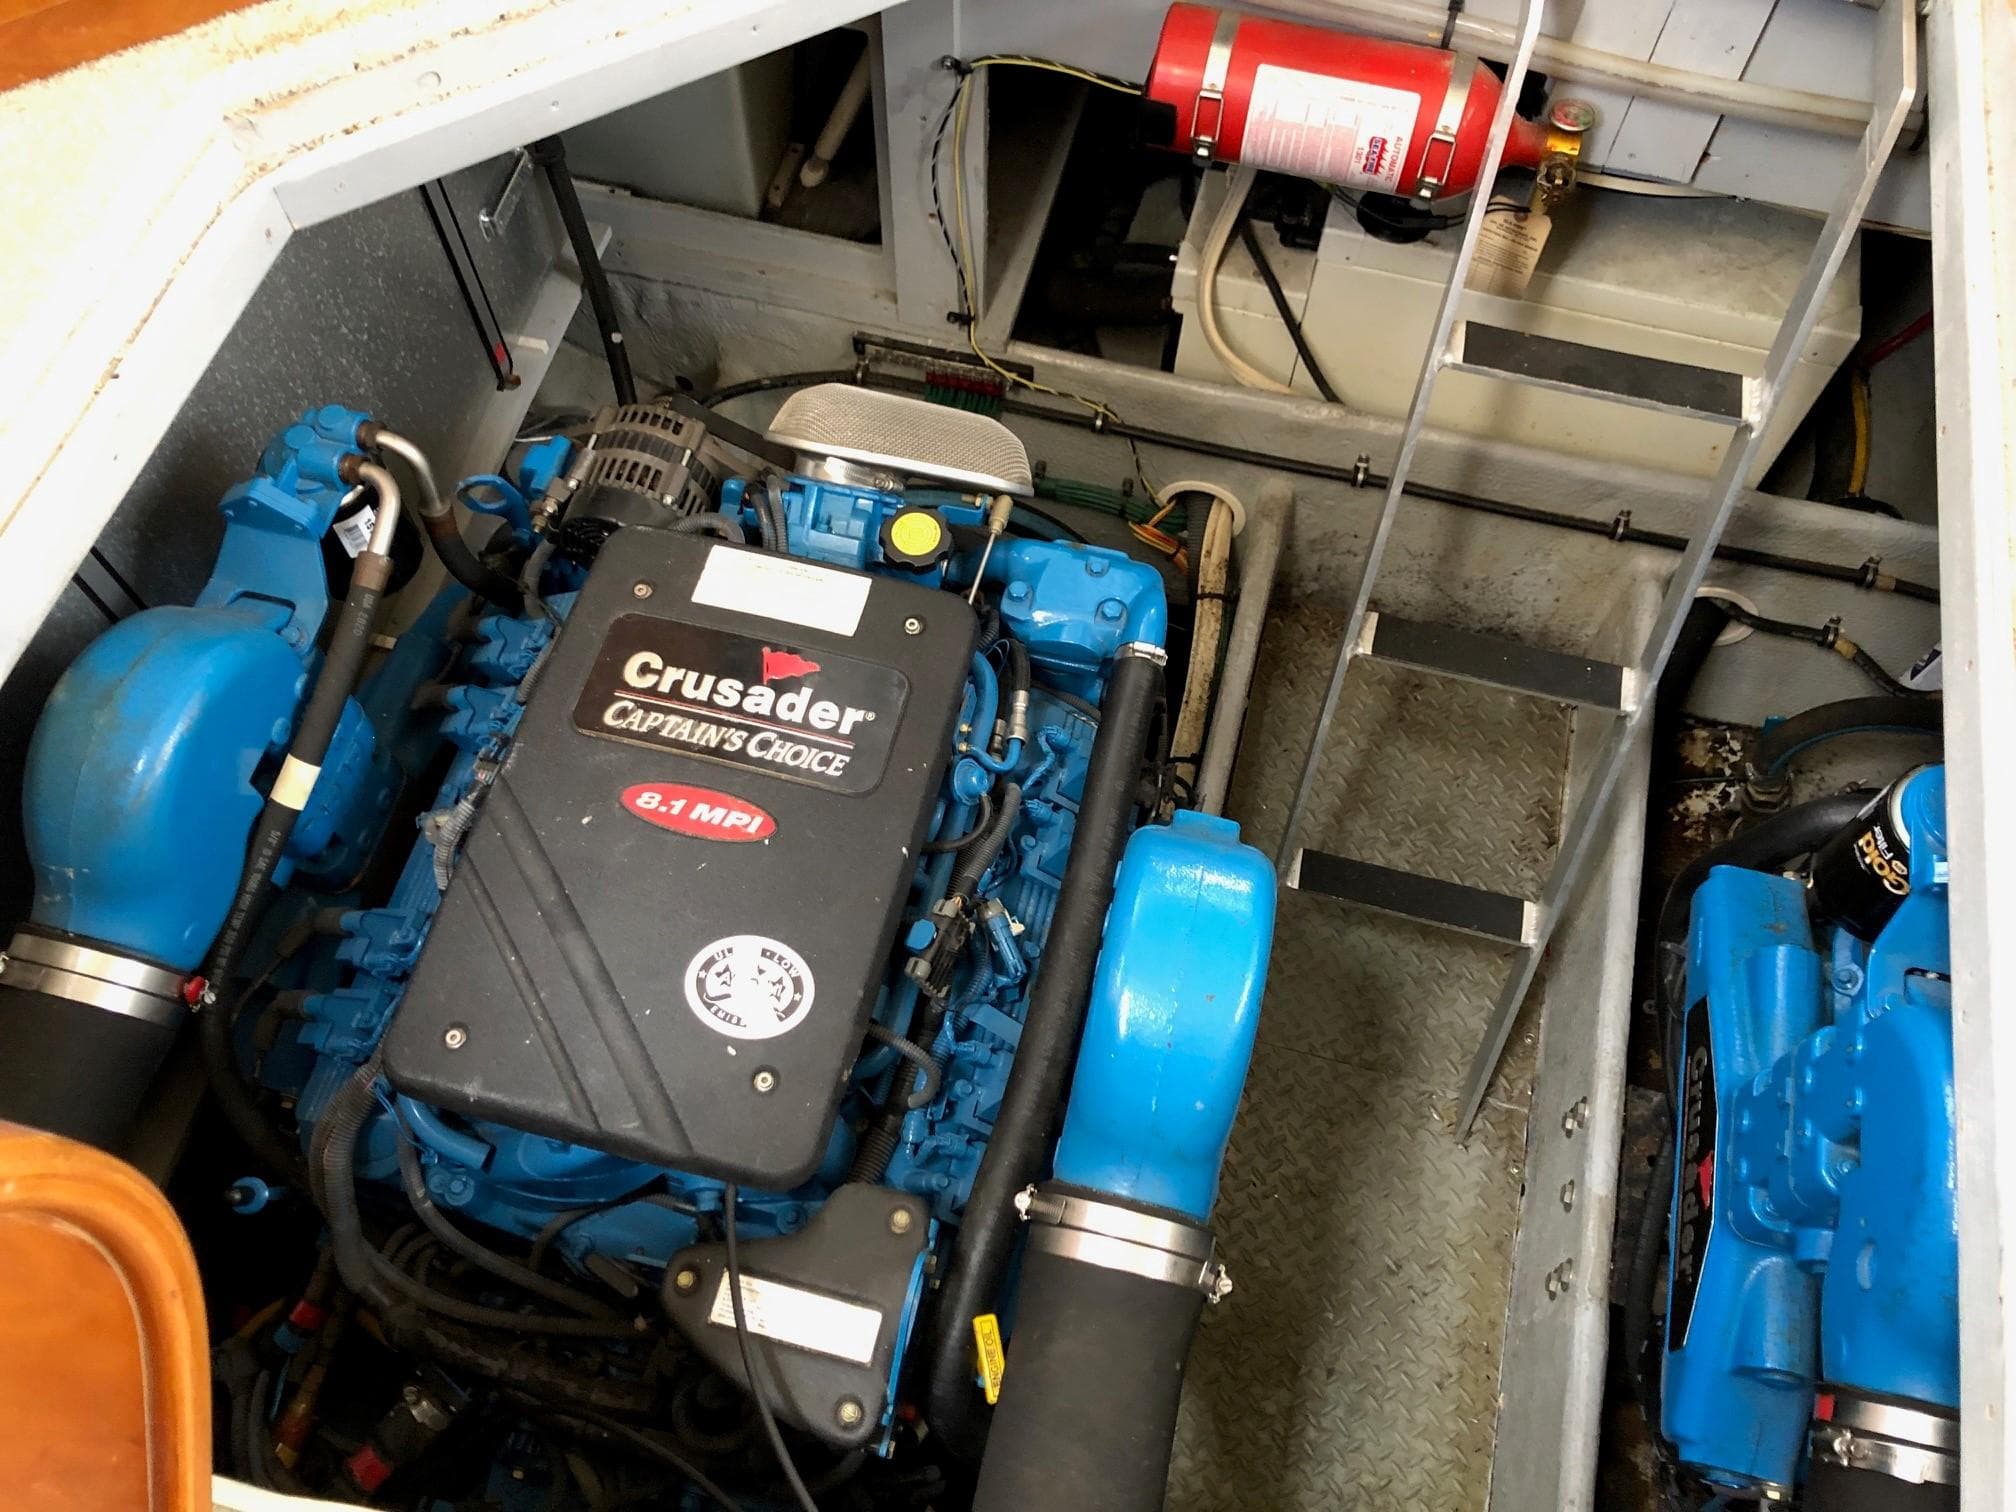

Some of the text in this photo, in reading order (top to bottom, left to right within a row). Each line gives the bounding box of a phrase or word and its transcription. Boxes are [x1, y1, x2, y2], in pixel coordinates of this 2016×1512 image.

[603, 700, 850, 778] CAPTAIN'S CHOICE
[635, 791, 765, 834] 8.1 MPI
[1858, 831, 1911, 895] Gold
[1873, 825, 1894, 860] Filter
[774, 955, 800, 977] LOW
[984, 1328, 999, 1388] ENGINE OIL
